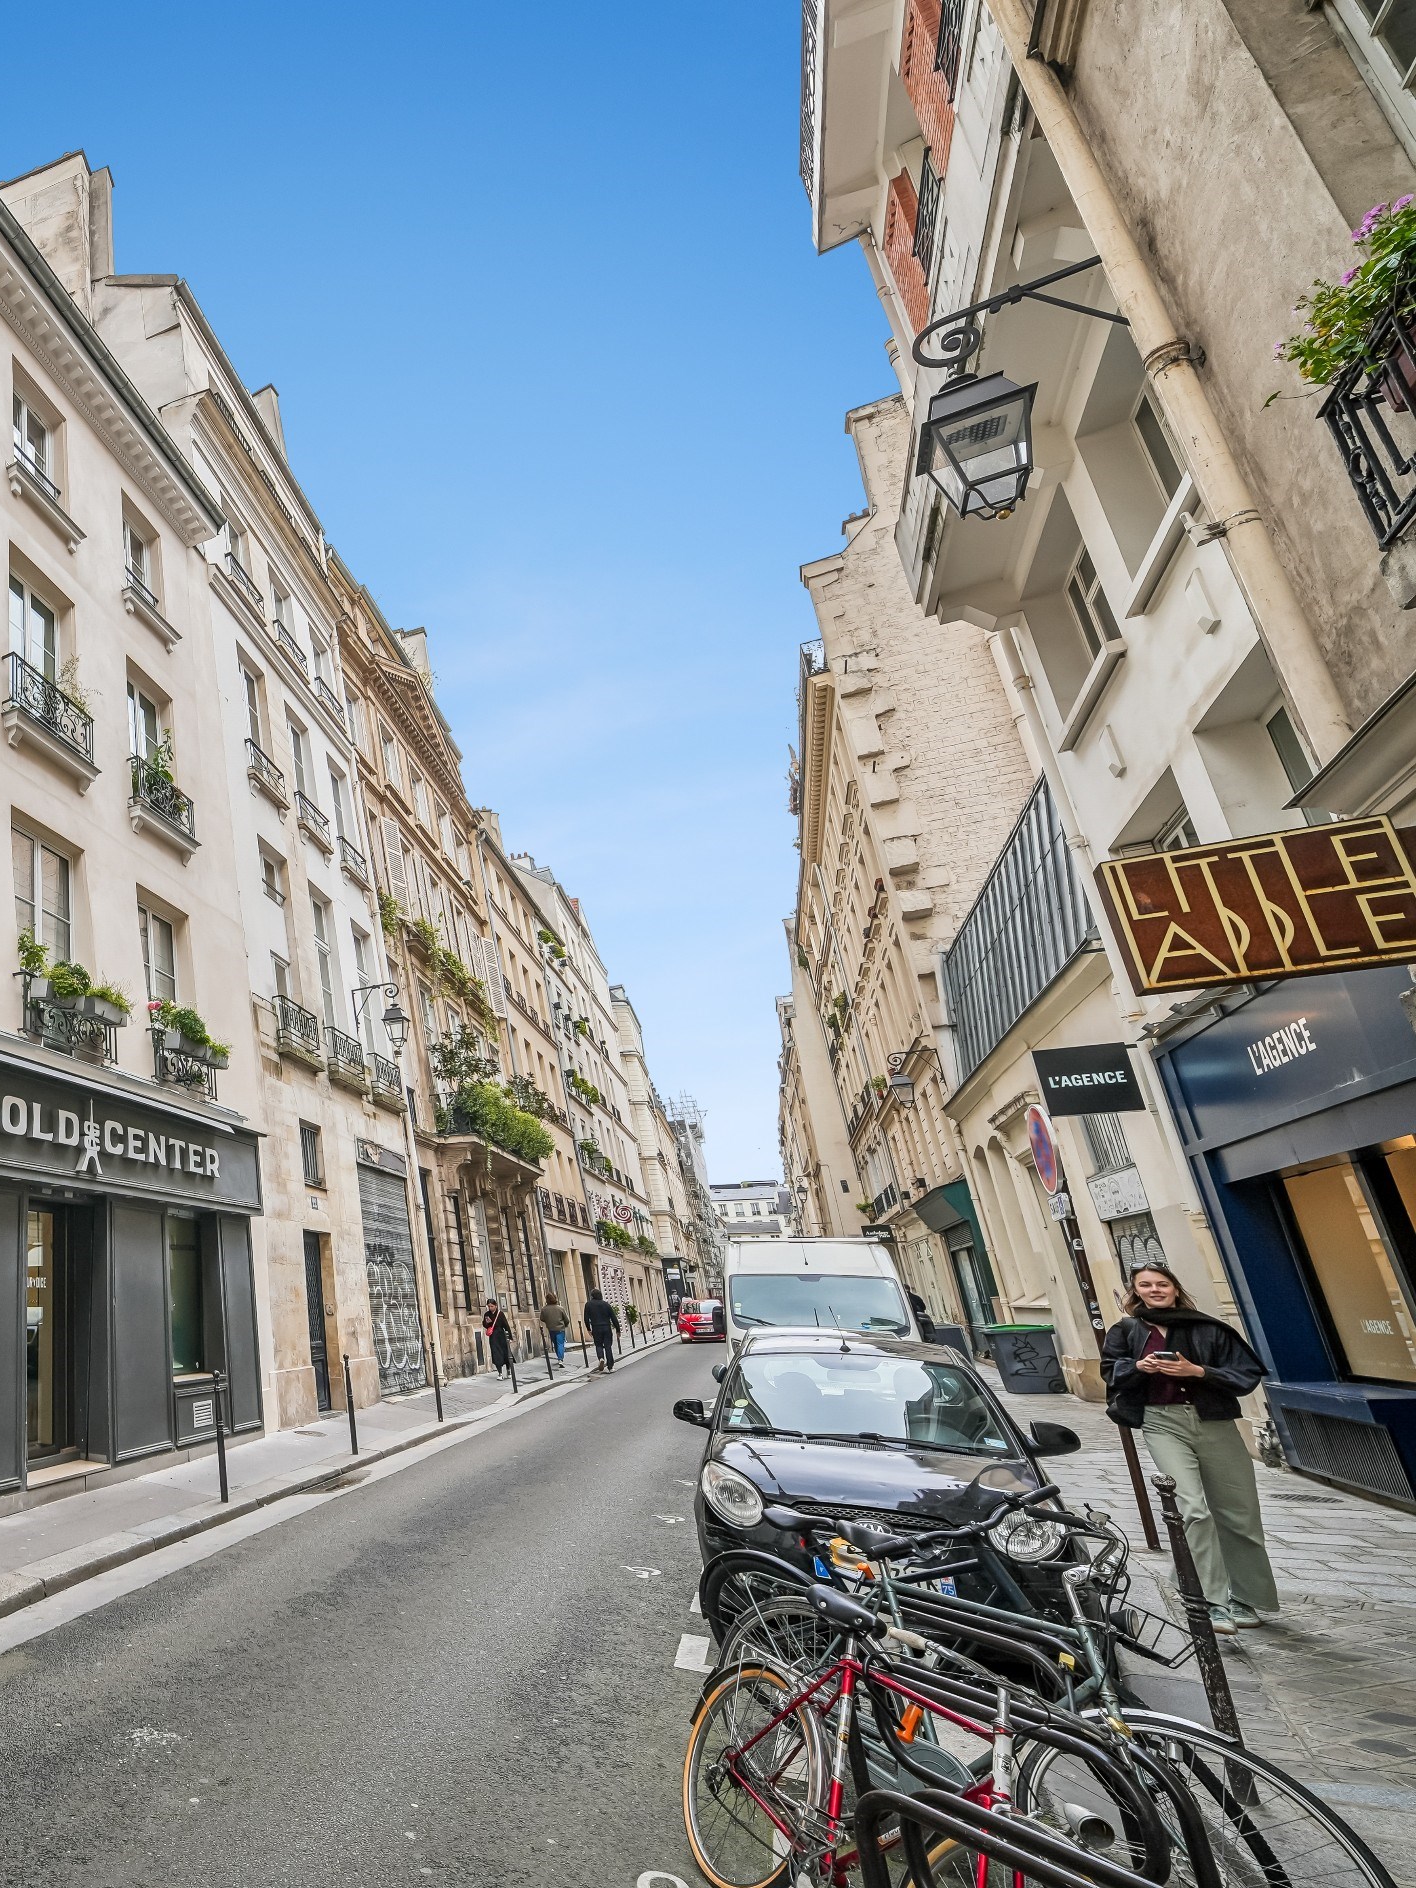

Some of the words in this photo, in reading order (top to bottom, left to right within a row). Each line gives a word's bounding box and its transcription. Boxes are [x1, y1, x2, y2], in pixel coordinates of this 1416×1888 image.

[1247, 1017, 1317, 1076] L'AGENCE
[1048, 1070, 1128, 1089] L'AGENCE
[103, 1119, 221, 1179] CENTER
[1360, 1319, 1394, 1335] L'AGENCE
[942, 1585, 955, 1596] 75
